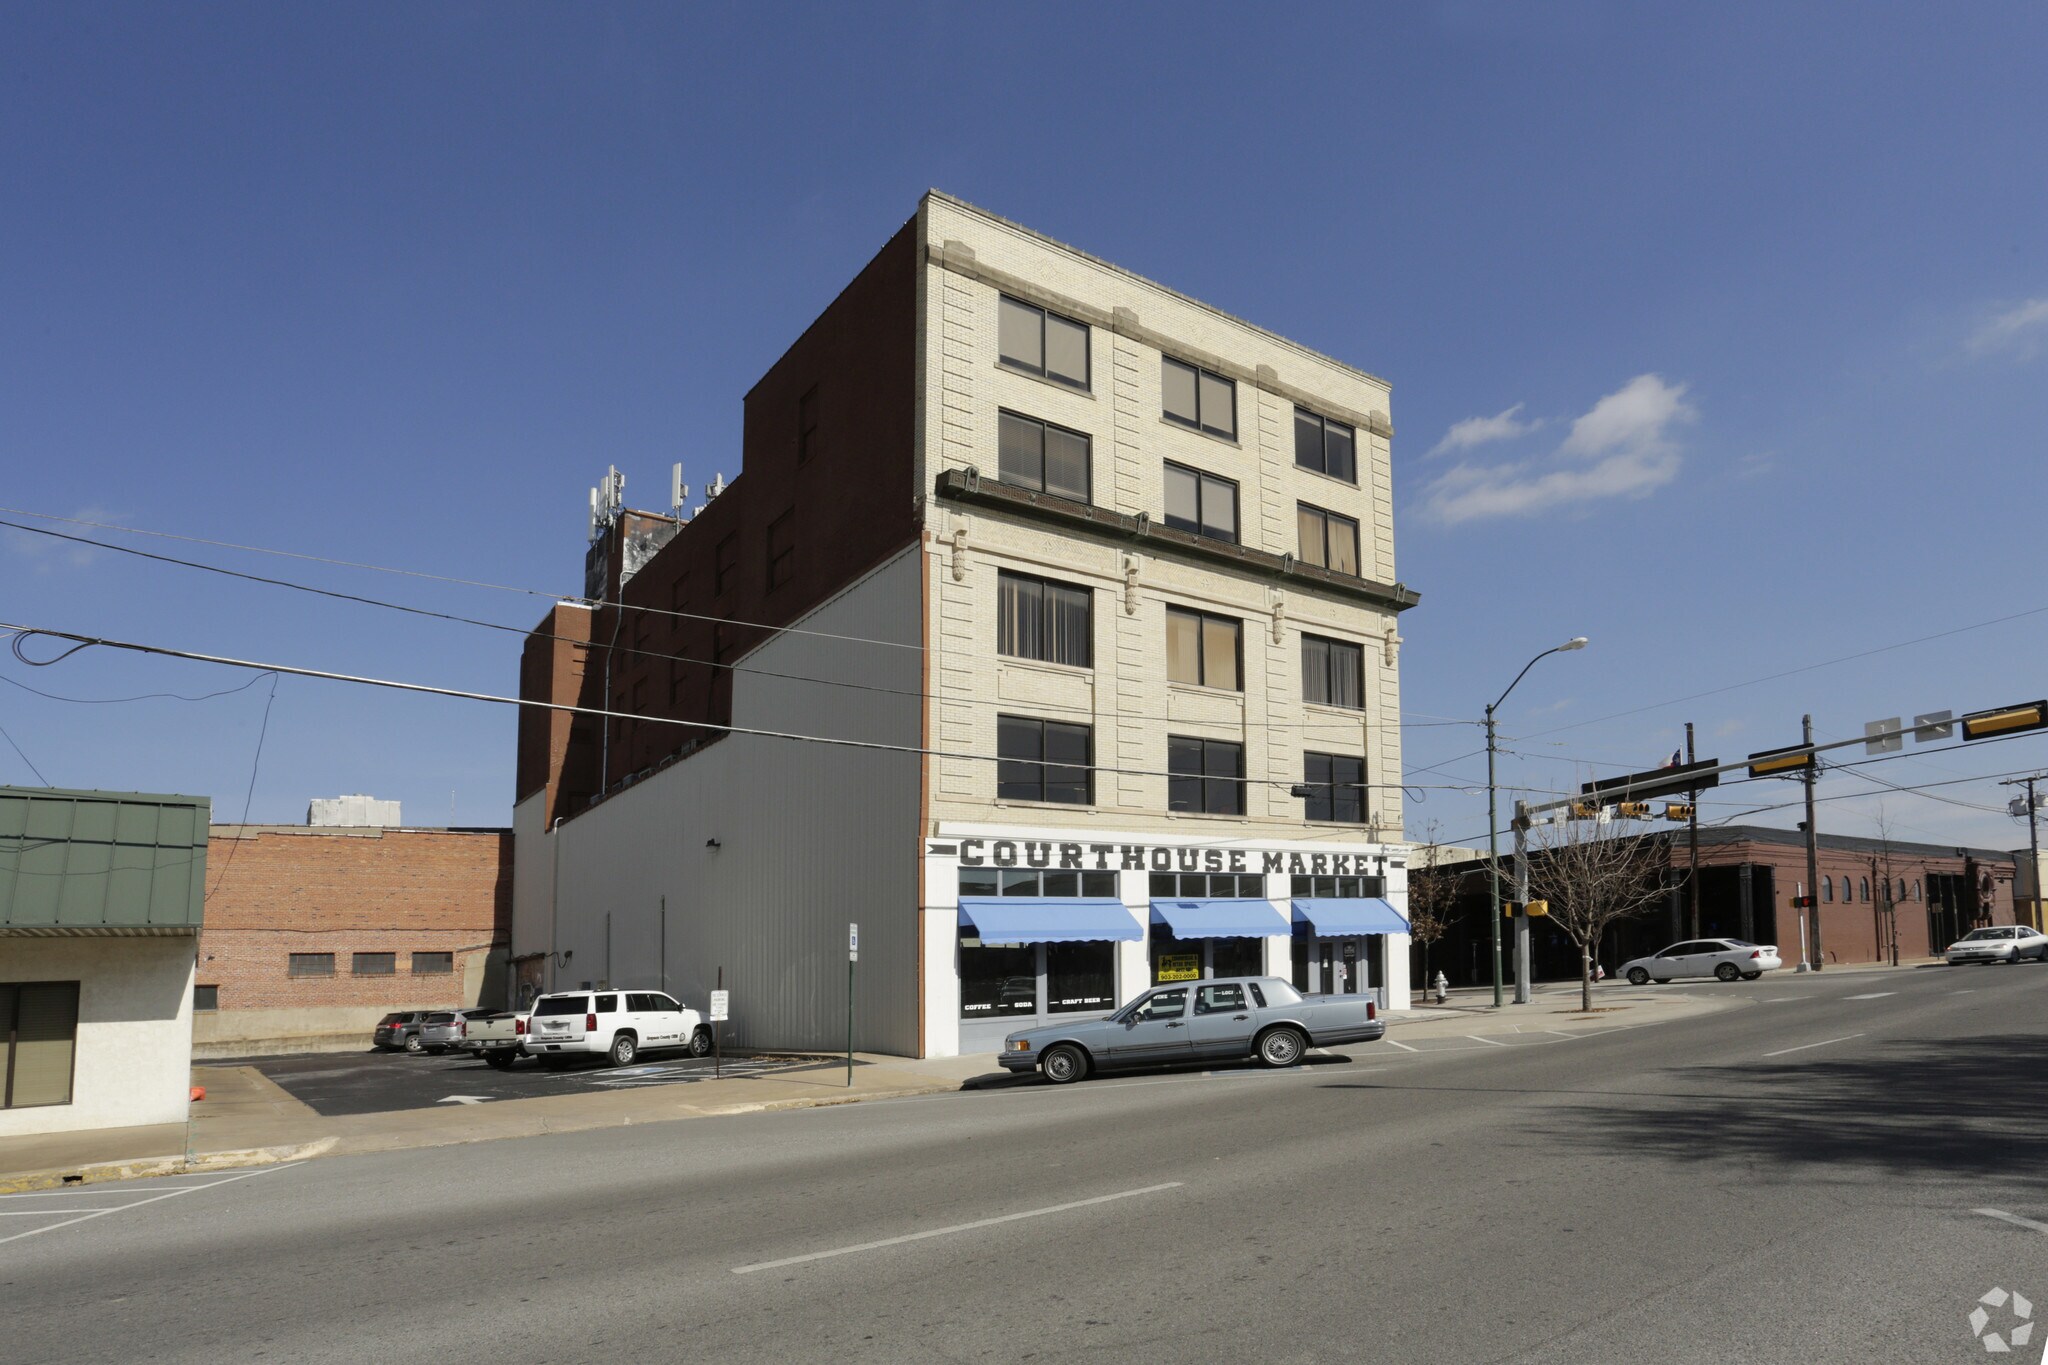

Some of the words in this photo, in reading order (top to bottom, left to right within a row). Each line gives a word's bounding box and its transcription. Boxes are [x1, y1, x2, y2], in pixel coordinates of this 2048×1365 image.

[960, 839, 1246, 872] COURTHOUSE
[1262, 851, 1388, 876] MARKET
[964, 1003, 991, 1011] COFFEE
